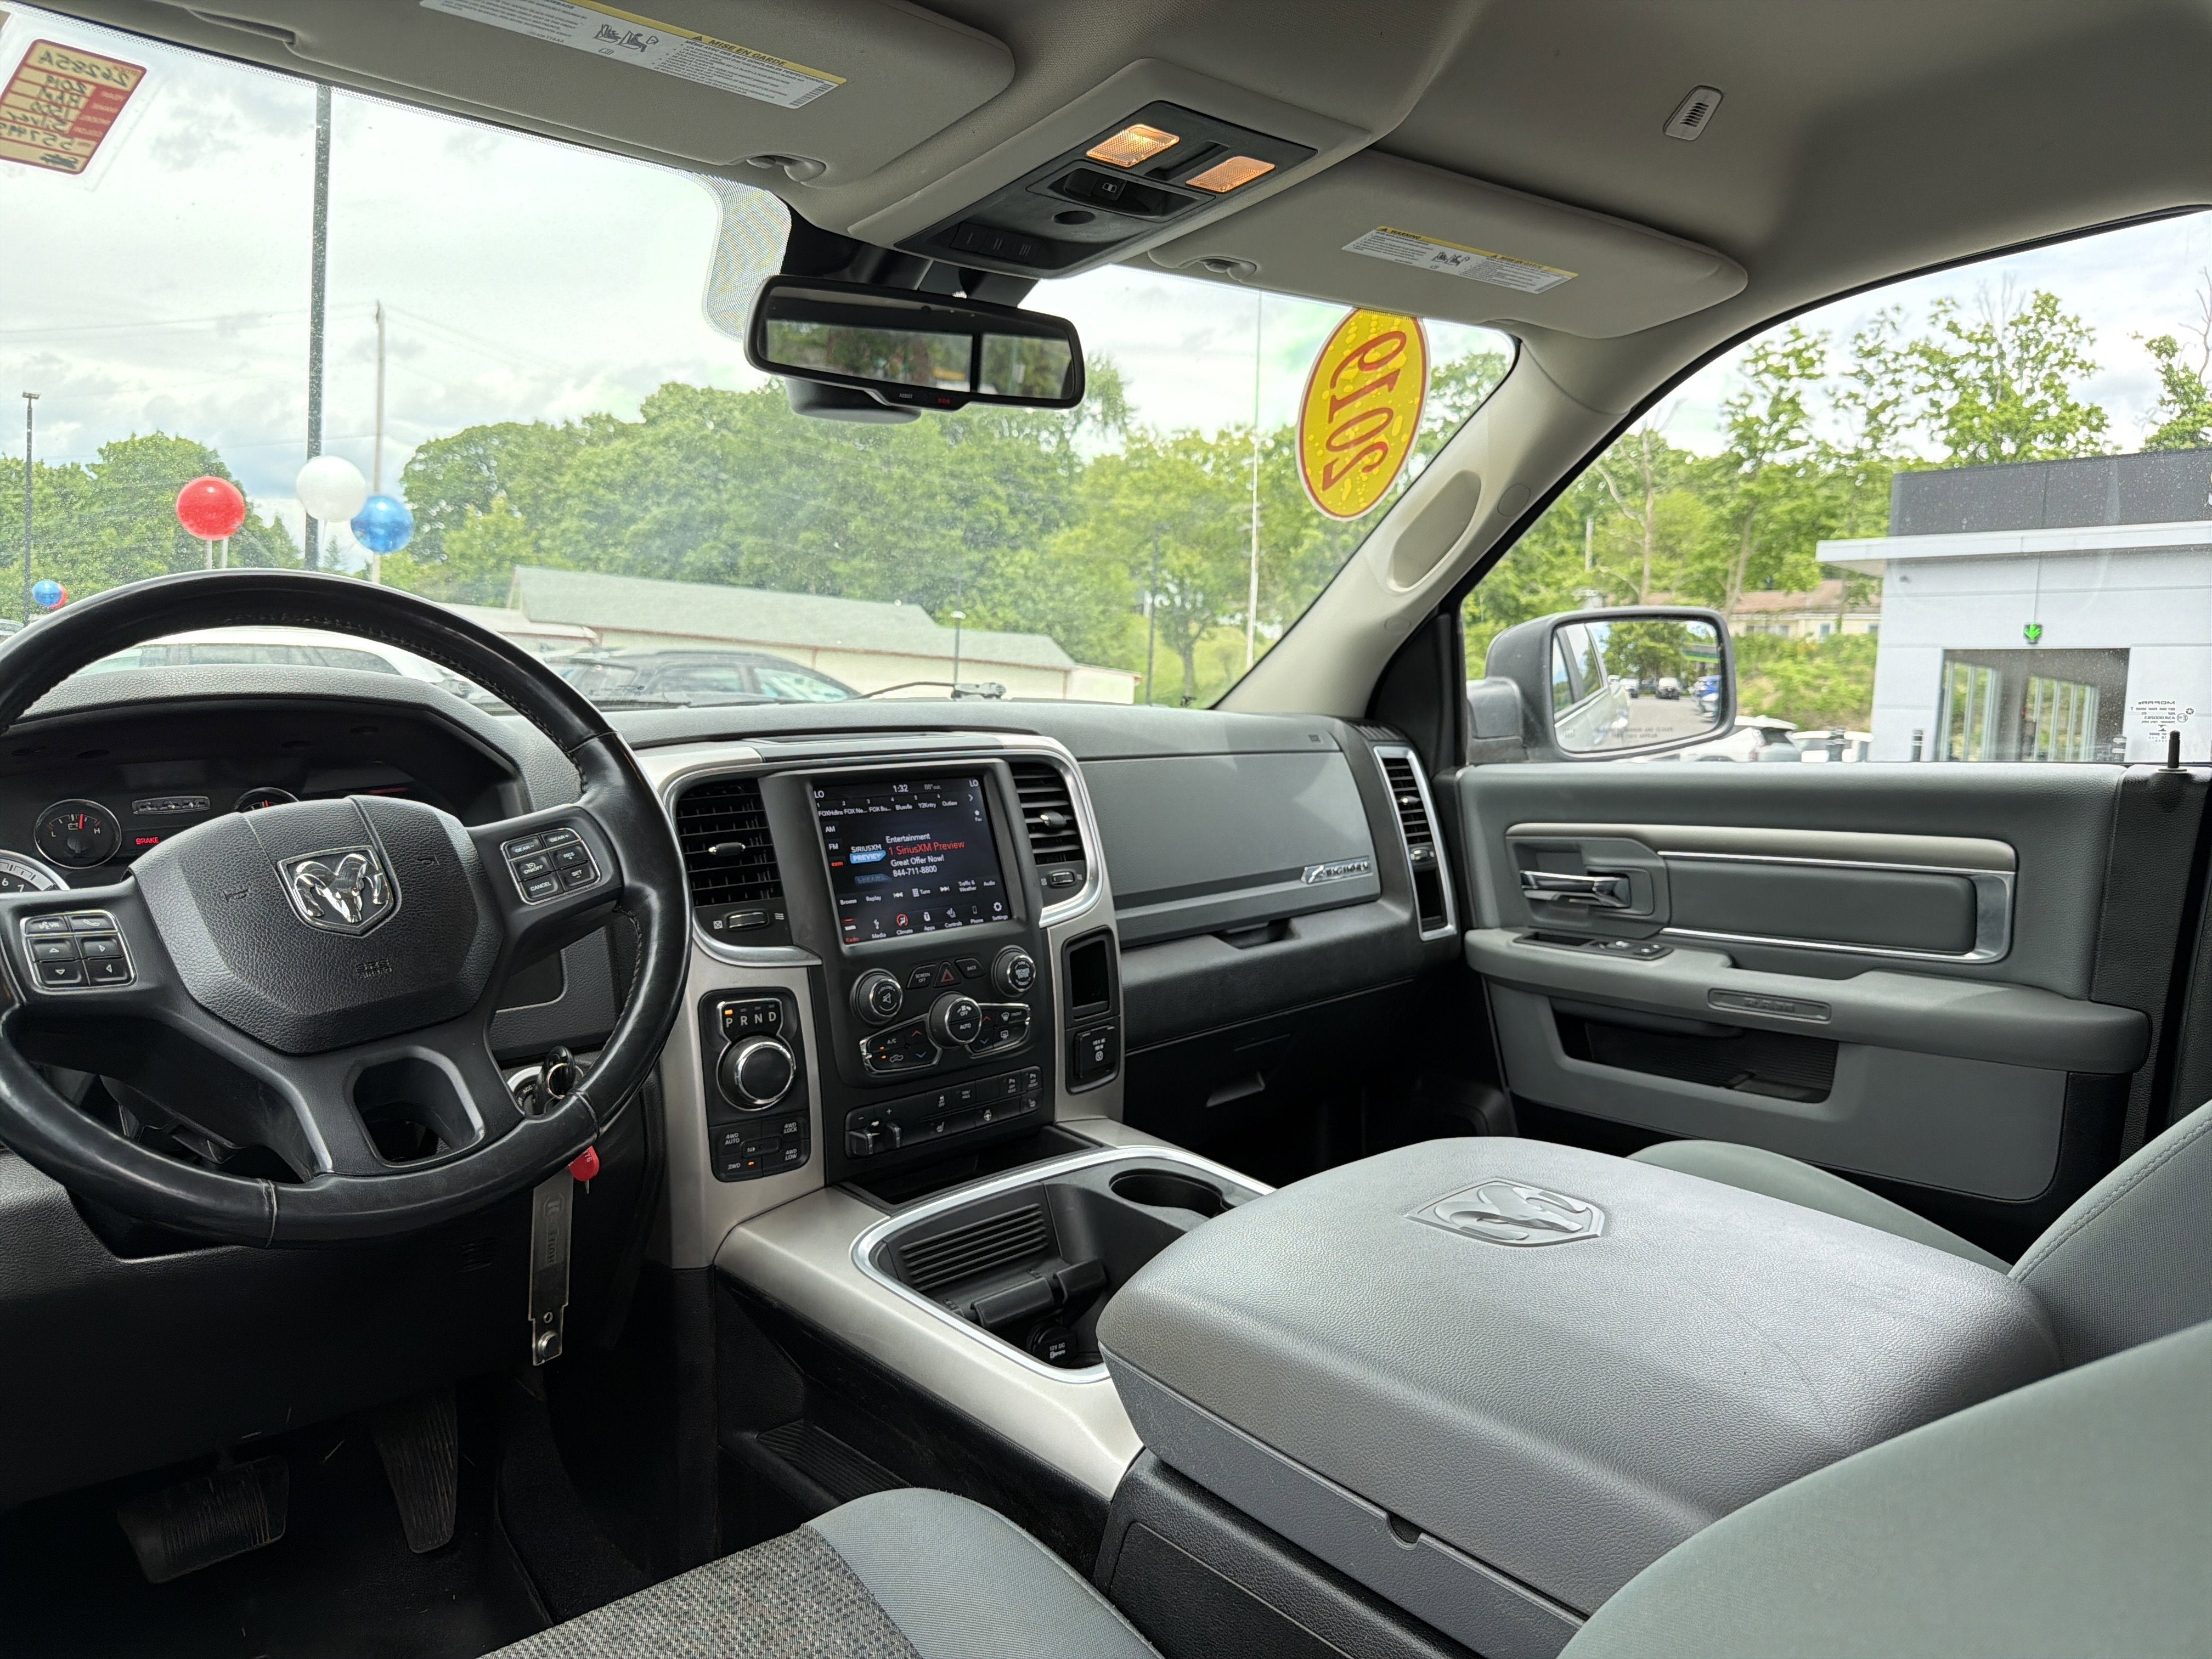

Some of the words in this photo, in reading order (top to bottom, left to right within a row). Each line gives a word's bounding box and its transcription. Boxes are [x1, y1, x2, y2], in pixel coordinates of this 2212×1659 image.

[708, 39, 736, 50] MISE
[751, 53, 787, 66] GARDE
[893, 784, 909, 793] 1:32
[814, 790, 825, 799] LO
[136, 837, 160, 845] BRAKE
[885, 833, 931, 844] Entertainment
[850, 844, 882, 853] SIRIUSXM
[888, 847, 894, 856] 1
[896, 842, 932, 855] SiriusXM
[933, 840, 966, 851] Preview
[890, 858, 910, 867] Great
[910, 856, 927, 865] Offer
[928, 854, 945, 863] Now!
[523, 865, 543, 874] ON/OFF
[893, 865, 938, 877] 844-711-8800
[1, 878, 9, 886] 6
[17, 884, 25, 893] 7
[530, 881, 552, 891] CANCEL
[725, 1018, 733, 1028] P
[740, 1015, 748, 1026] R
[754, 1013, 763, 1024] N
[769, 1012, 777, 1022] D
[724, 1137, 740, 1146] AUTO
[727, 1162, 741, 1170] 2WD
